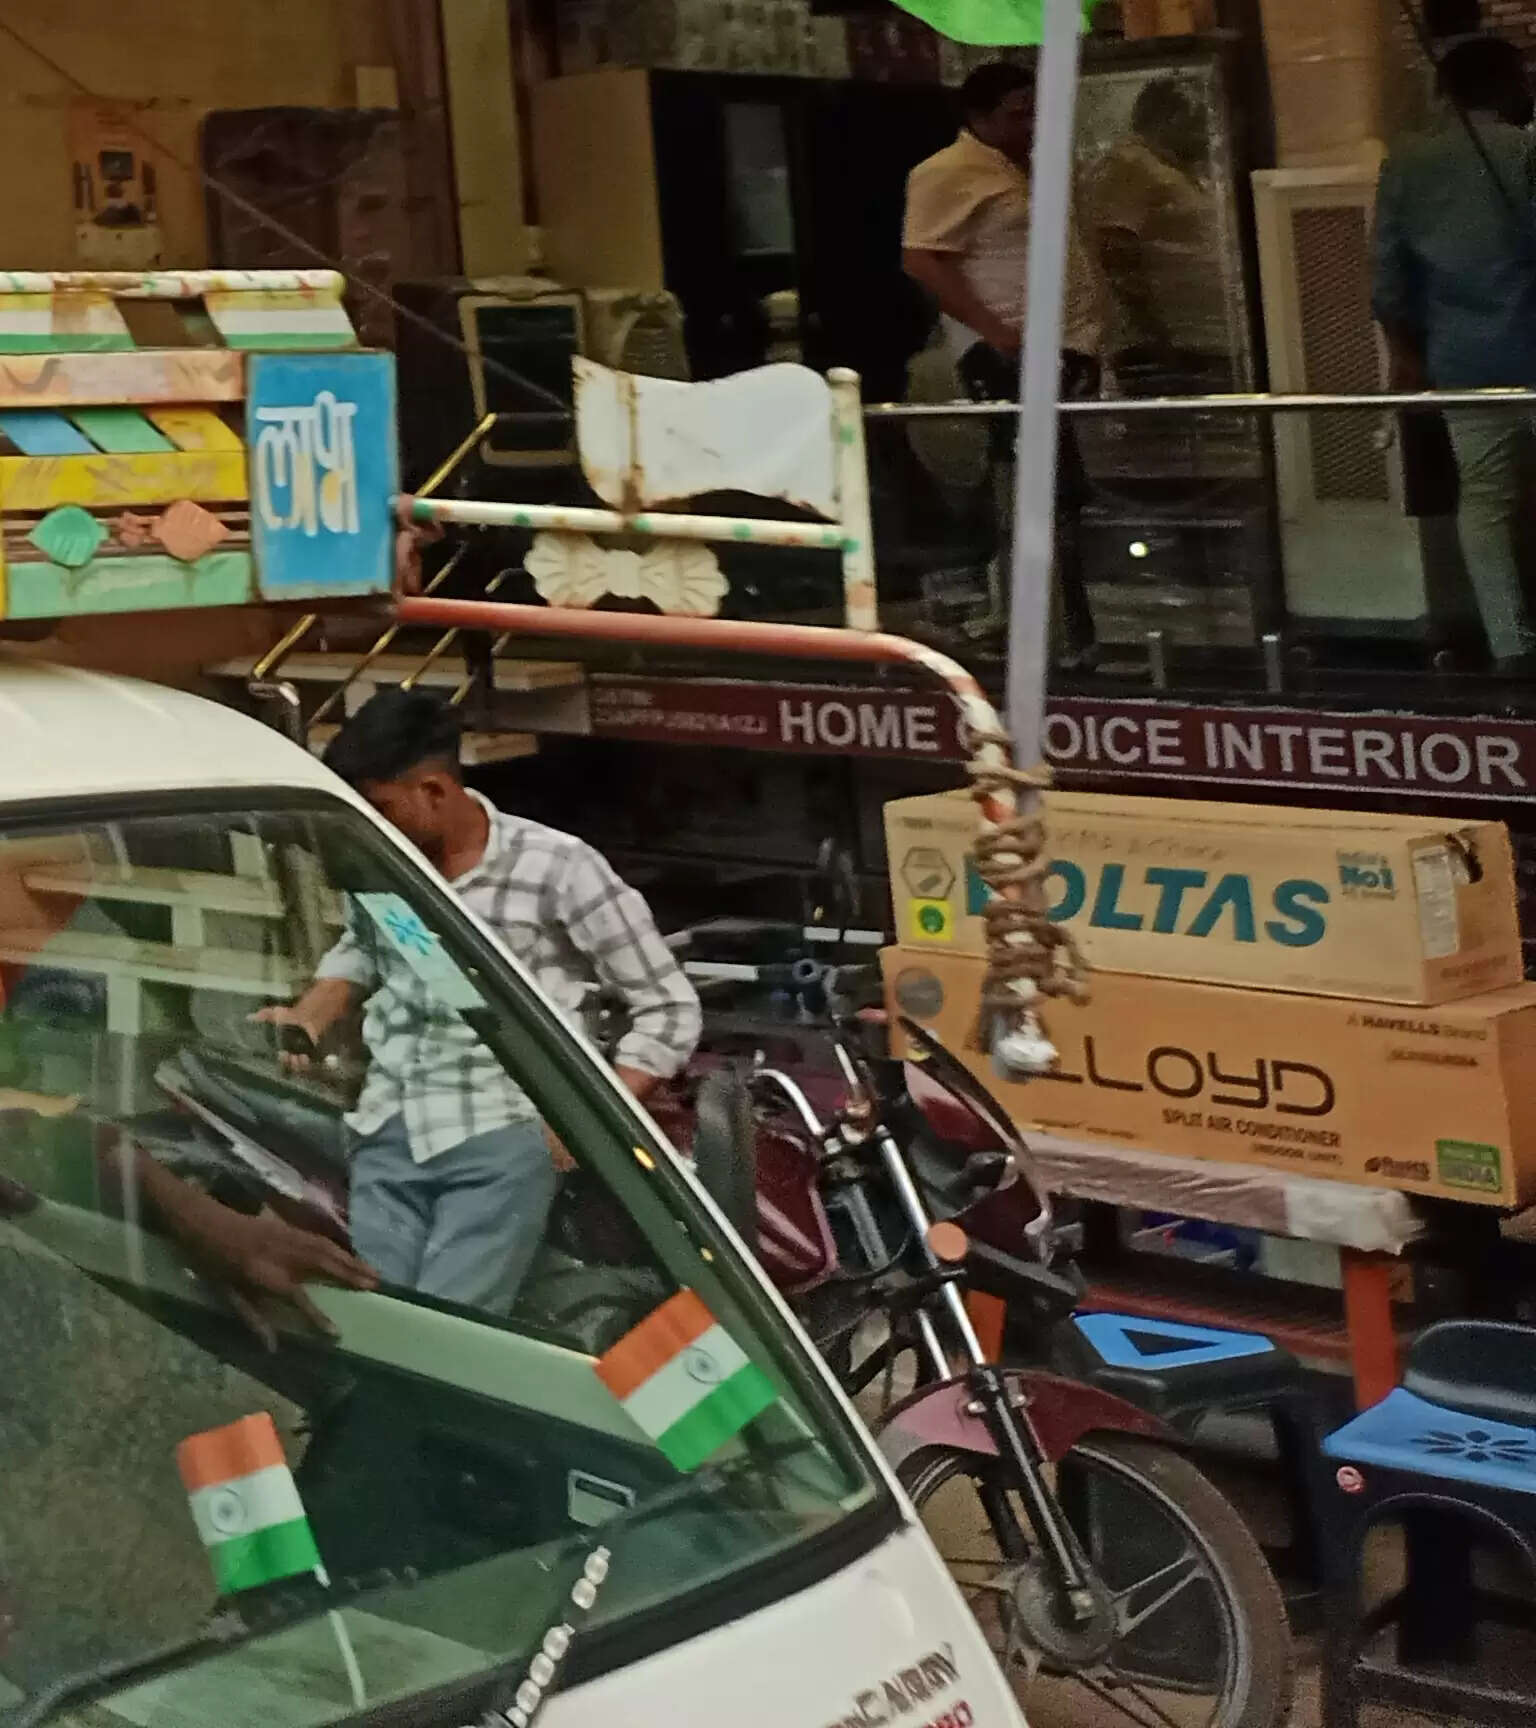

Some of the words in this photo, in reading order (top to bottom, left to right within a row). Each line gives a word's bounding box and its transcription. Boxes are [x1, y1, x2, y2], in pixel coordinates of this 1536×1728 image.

[256, 390, 361, 537] लाभ
[778, 698, 939, 752] HOME
[1203, 721, 1527, 787] INTERIOR
[1235, 1120, 1342, 1149] CONDITIONER
